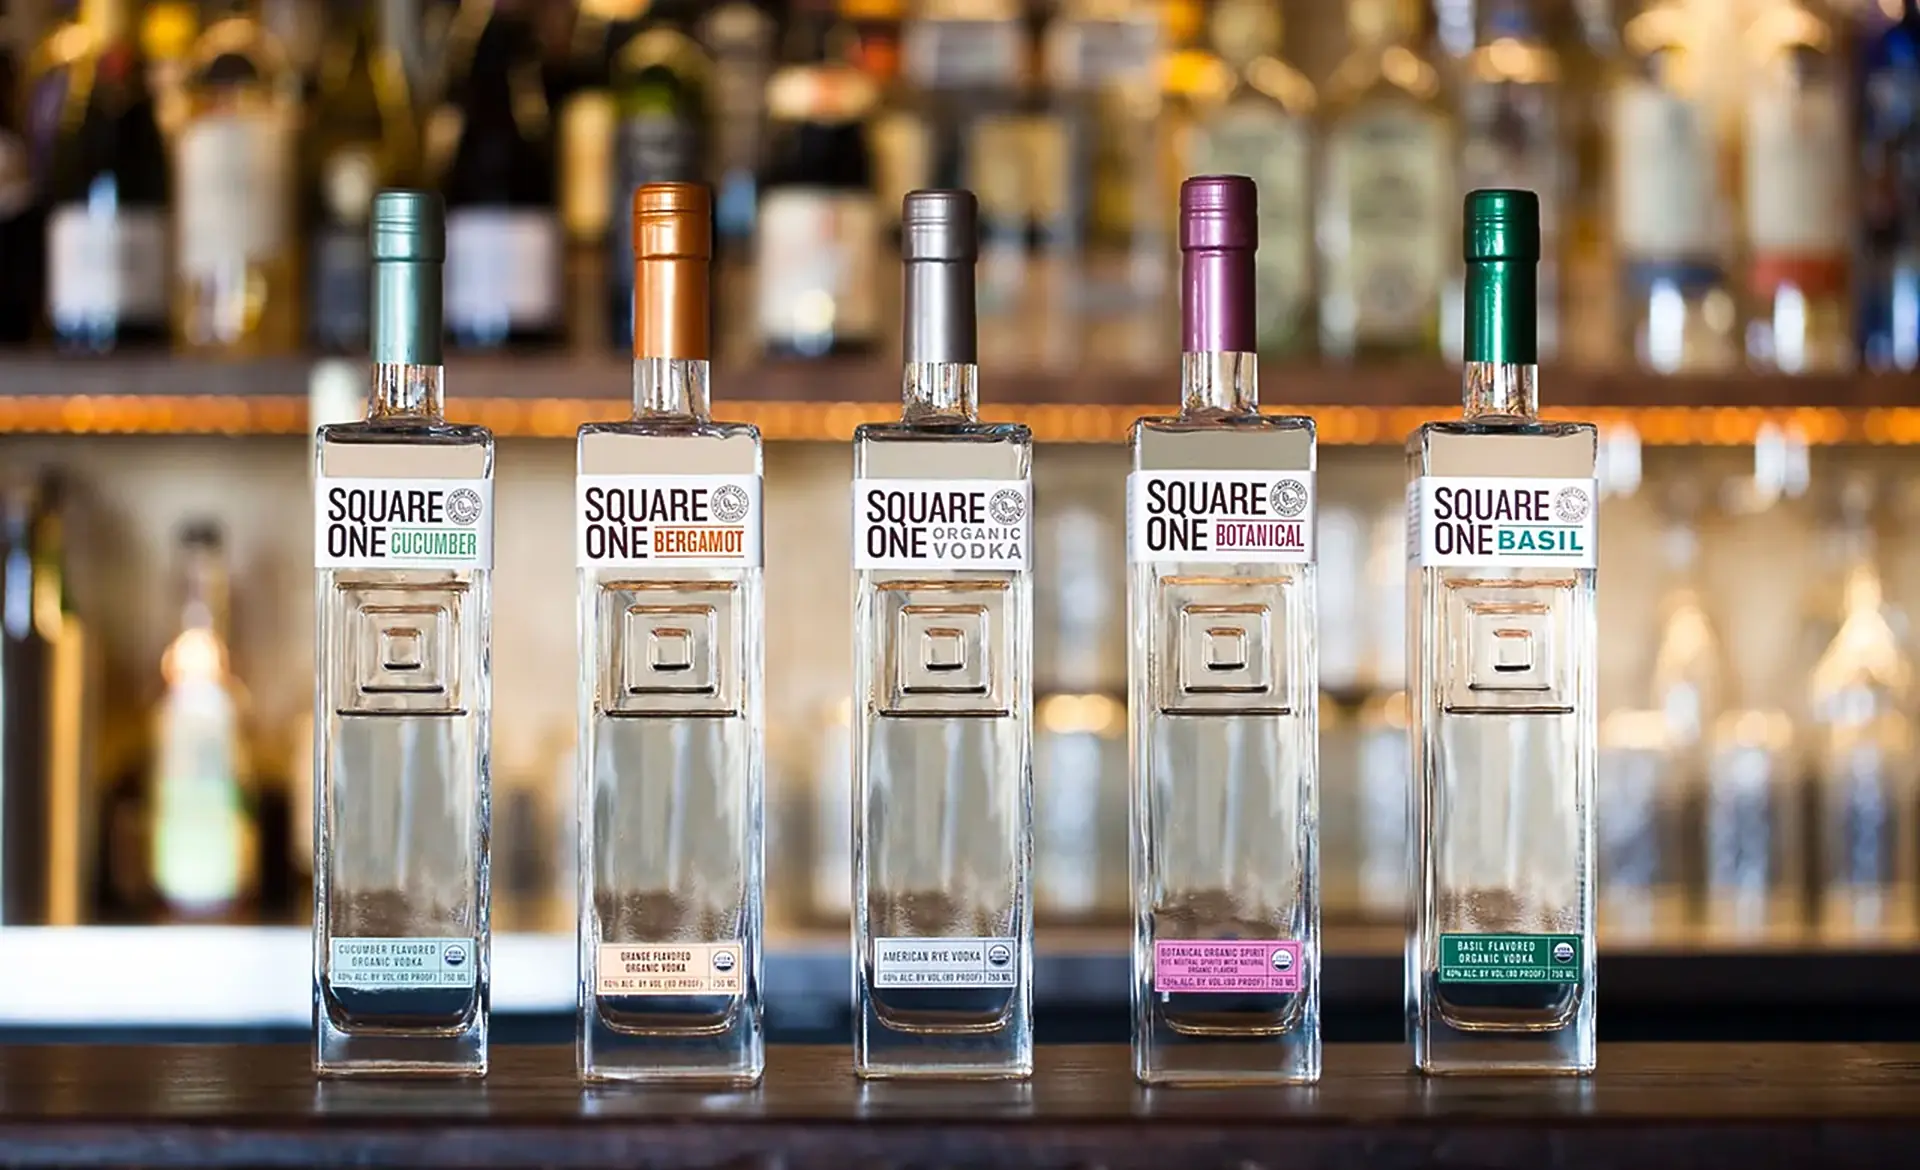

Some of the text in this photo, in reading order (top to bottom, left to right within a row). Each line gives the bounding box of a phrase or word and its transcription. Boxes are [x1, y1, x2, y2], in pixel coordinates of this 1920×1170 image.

[1147, 479, 1267, 518] SQUARE
[328, 487, 443, 526] SQUARE
[585, 487, 708, 526] SQUARE
[867, 489, 985, 527] SQUARE
[1434, 486, 1549, 524] SQUARE
[933, 527, 1021, 540] ORGANIC
[1147, 516, 1208, 551] ONE
[1216, 524, 1304, 547] BOTANICAL
[1435, 522, 1584, 555] ONE BASIL
[328, 523, 477, 557] ONE CUCUMBER
[586, 524, 744, 559] ONE BERGAMOT
[867, 525, 927, 558] ONE
[933, 542, 1022, 560] VODKA
[338, 945, 436, 954] CUCUMBER FLAVORED
[1457, 941, 1536, 952] BASIL FLAVORED
[620, 952, 691, 961] ORANGE FLAVORED
[882, 951, 929, 962] AMERICAN
[932, 951, 949, 962] RYE
[952, 951, 982, 962] VODKA
[1161, 948, 1264, 957] BOTANICAL ORGANIC SPIRIT
[352, 957, 422, 966] ORGANIC VODKA
[1458, 954, 1534, 964] ORGANIC VODKA
[625, 964, 686, 972] ORGANIC VODKA
[1446, 969, 1462, 978] 40%
[1480, 969, 1489, 978] BY
[1520, 969, 1546, 978] PROOF)
[371, 972, 380, 981] BY
[916, 973, 925, 981] BY
[988, 973, 1000, 981] 750
[1552, 970, 1564, 978] 750
[1196, 978, 1206, 986] BY
